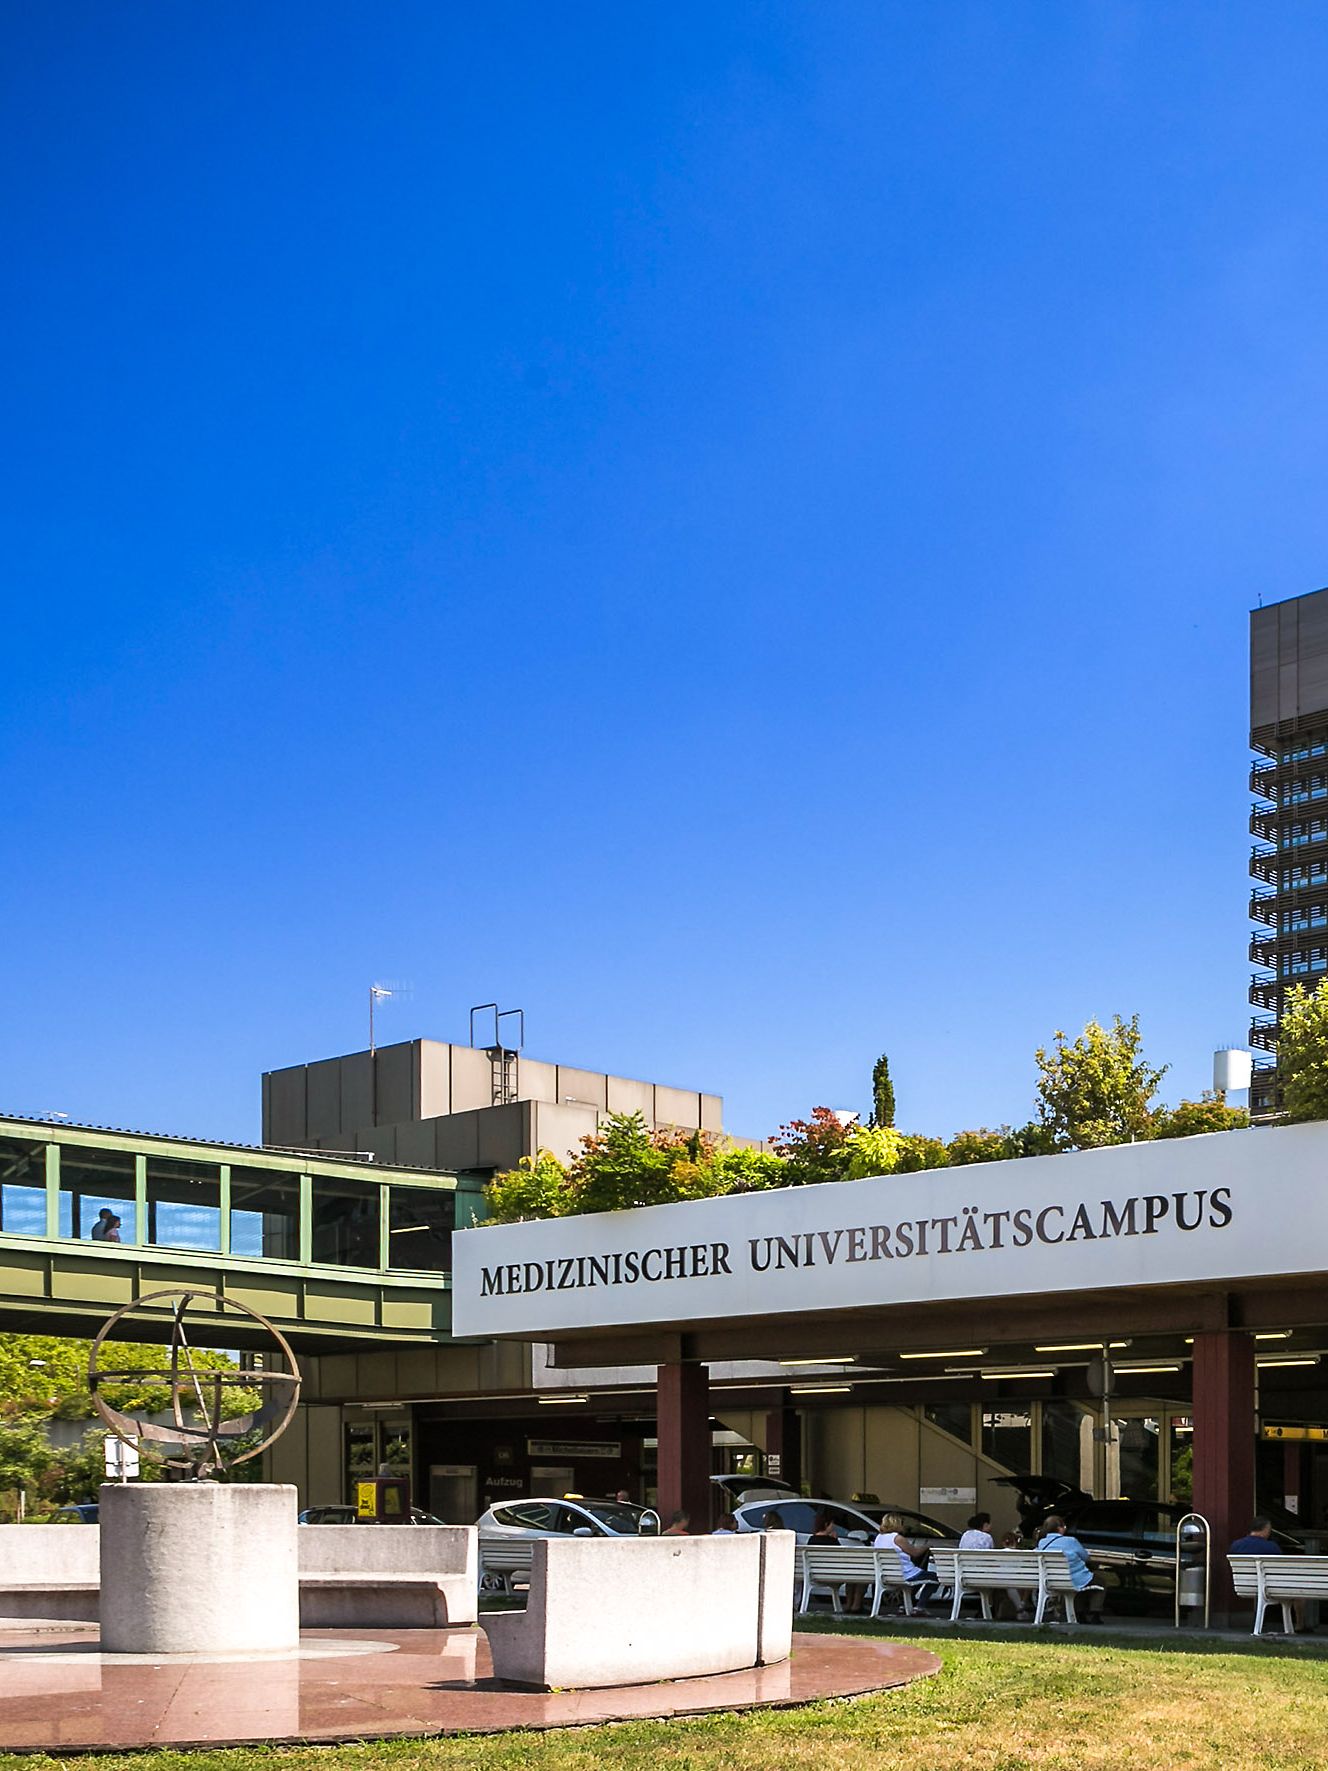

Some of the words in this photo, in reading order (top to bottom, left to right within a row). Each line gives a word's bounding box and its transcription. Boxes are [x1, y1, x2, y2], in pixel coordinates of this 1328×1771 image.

[479, 1242, 733, 1297] MEDIZINISCHER
[748, 1187, 1234, 1273] UNIVERSITÄTSCAMPUS
[485, 1476, 523, 1488] Aufzug
